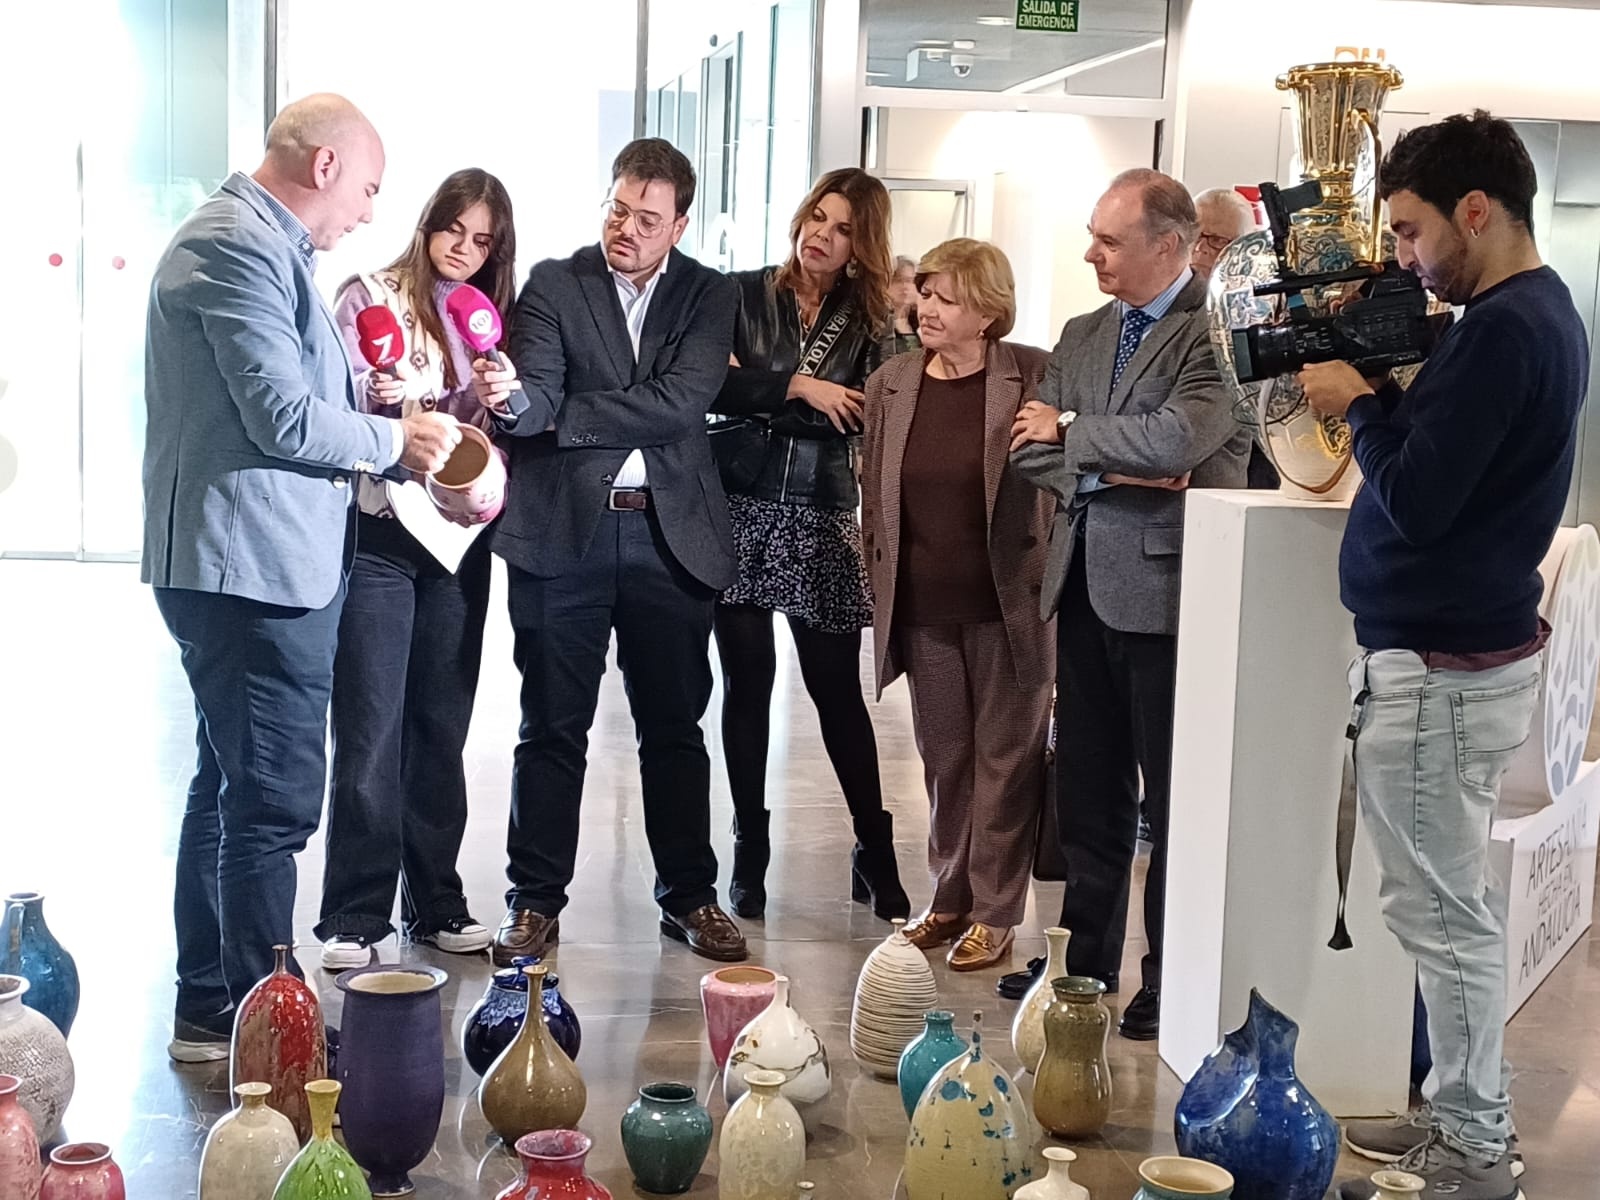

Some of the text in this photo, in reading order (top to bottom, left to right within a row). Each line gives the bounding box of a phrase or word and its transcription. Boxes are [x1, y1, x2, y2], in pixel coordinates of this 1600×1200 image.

[1022, 0, 1075, 16] SALIDA DE
[1019, 14, 1076, 29] EMERGENCIA
